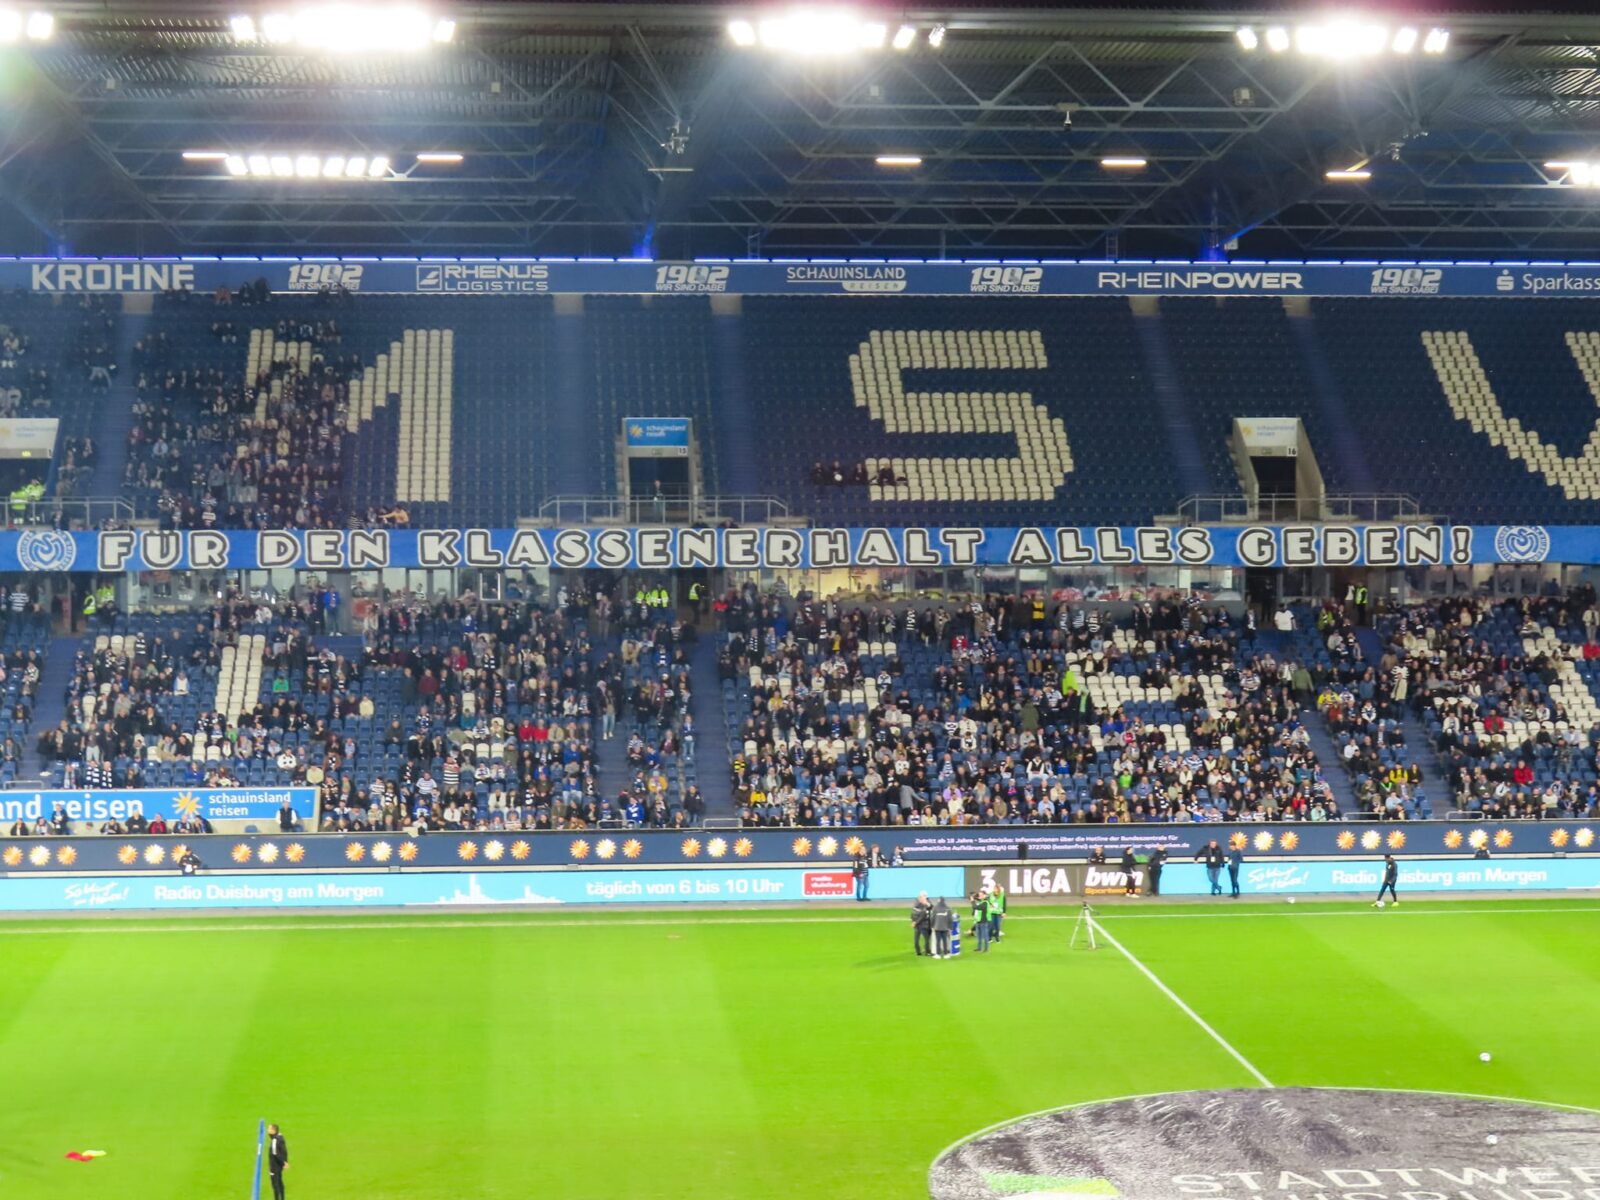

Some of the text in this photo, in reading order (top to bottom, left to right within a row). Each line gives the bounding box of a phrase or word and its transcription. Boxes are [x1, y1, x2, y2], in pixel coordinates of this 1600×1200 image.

[32, 264, 194, 290] KROHNE
[289, 264, 364, 283] 1902
[445, 265, 549, 278] RHENUS
[656, 265, 730, 284] 1902
[787, 267, 905, 279] SCHAUINSLAND
[971, 267, 1043, 285] 1902
[1371, 268, 1442, 286] 1902
[445, 281, 549, 291] LOGISTICS
[656, 283, 726, 292] WIR SIND DABEI
[1012, 285, 1039, 293] DABEI
[1098, 272, 1303, 289] RHEINPOWER
[1412, 286, 1438, 294] DABEI
[1287, 447, 1297, 455] 16
[98, 529, 229, 571] FÜR
[257, 529, 391, 569] DEN
[417, 526, 983, 569] KLASSENERHALT
[1008, 526, 1213, 565] ALLES
[1236, 525, 1473, 566] GEBEN!
[209, 791, 291, 804] schauinsland
[209, 805, 249, 816] reisen
[1009, 868, 1071, 894] LIGA
[1332, 868, 1548, 886] Radio uisburg am Morgen
[155, 883, 384, 901] Radio Duisburg am Morgen
[586, 879, 784, 898] täglich von 6 bis 10 Uhr
